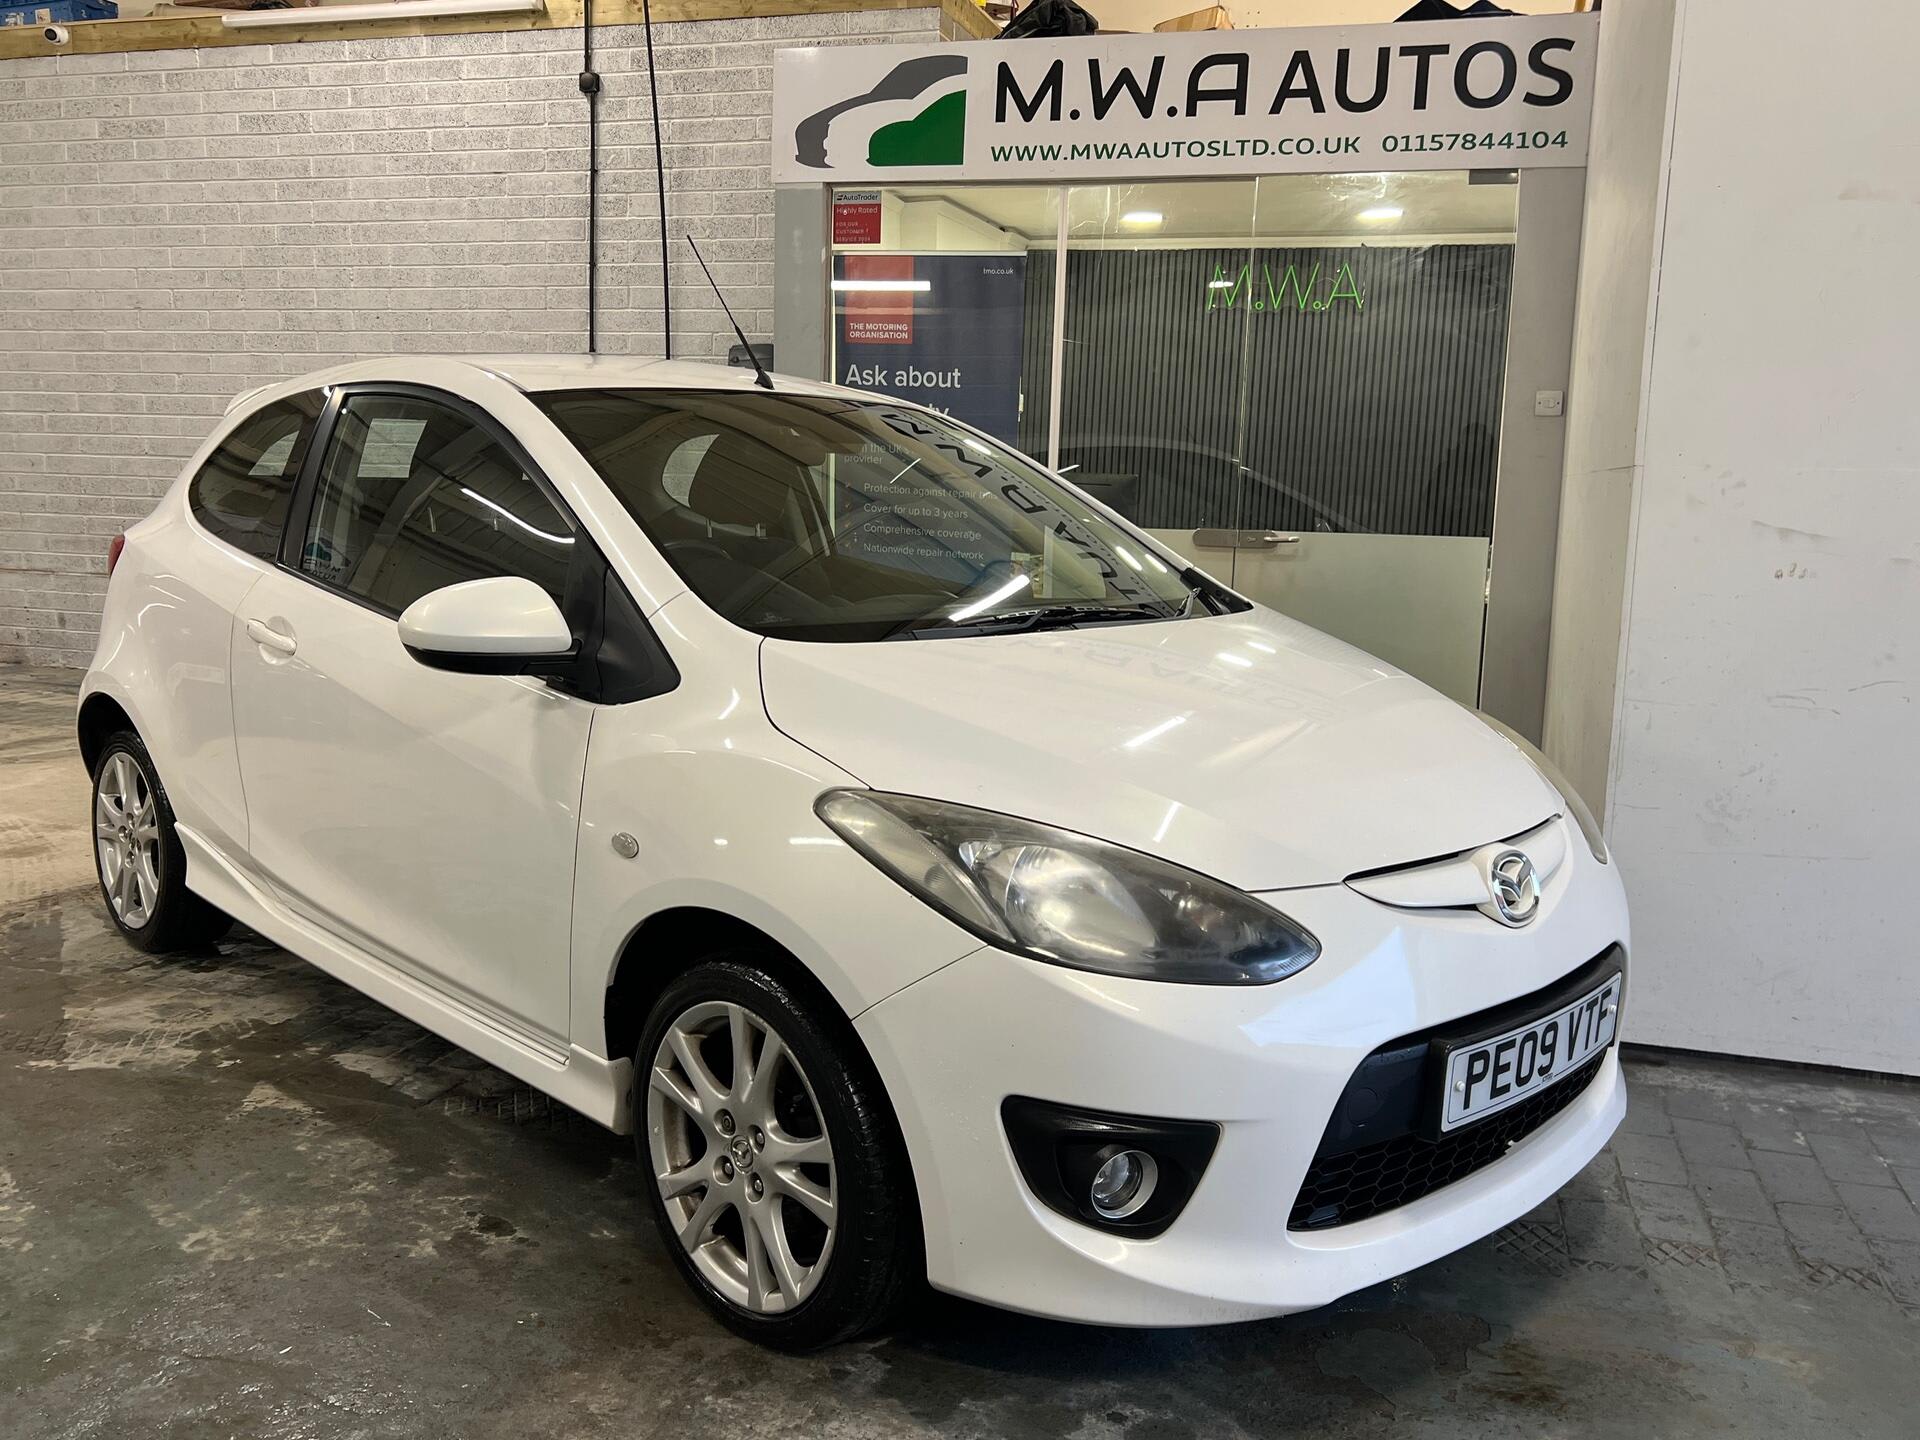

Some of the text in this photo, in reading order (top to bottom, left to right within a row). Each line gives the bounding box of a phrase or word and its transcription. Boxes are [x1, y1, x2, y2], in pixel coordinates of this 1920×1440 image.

[994, 37, 1576, 123] M.W.A AUTOS
[991, 130, 1569, 162] WWW.MWAAUTOSLTD.CO.UK 01157844104
[858, 206, 878, 214] Rated
[983, 267, 1014, 275] tmo.co.uk
[1208, 262, 1363, 310] M.W.A
[849, 322, 908, 331] THE MOTORING
[849, 331, 908, 339] ORGANISATION
[845, 363, 961, 389] Ask about
[843, 454, 883, 464] provider
[864, 482, 911, 495] Protection
[913, 487, 946, 498] against
[949, 489, 977, 500] repair
[864, 503, 969, 521] Cover for up to 3 years
[864, 523, 982, 542] Comprehensive coverage
[864, 543, 984, 561] Nationwide repair network
[1463, 986, 1613, 1111] PE09 VTF
